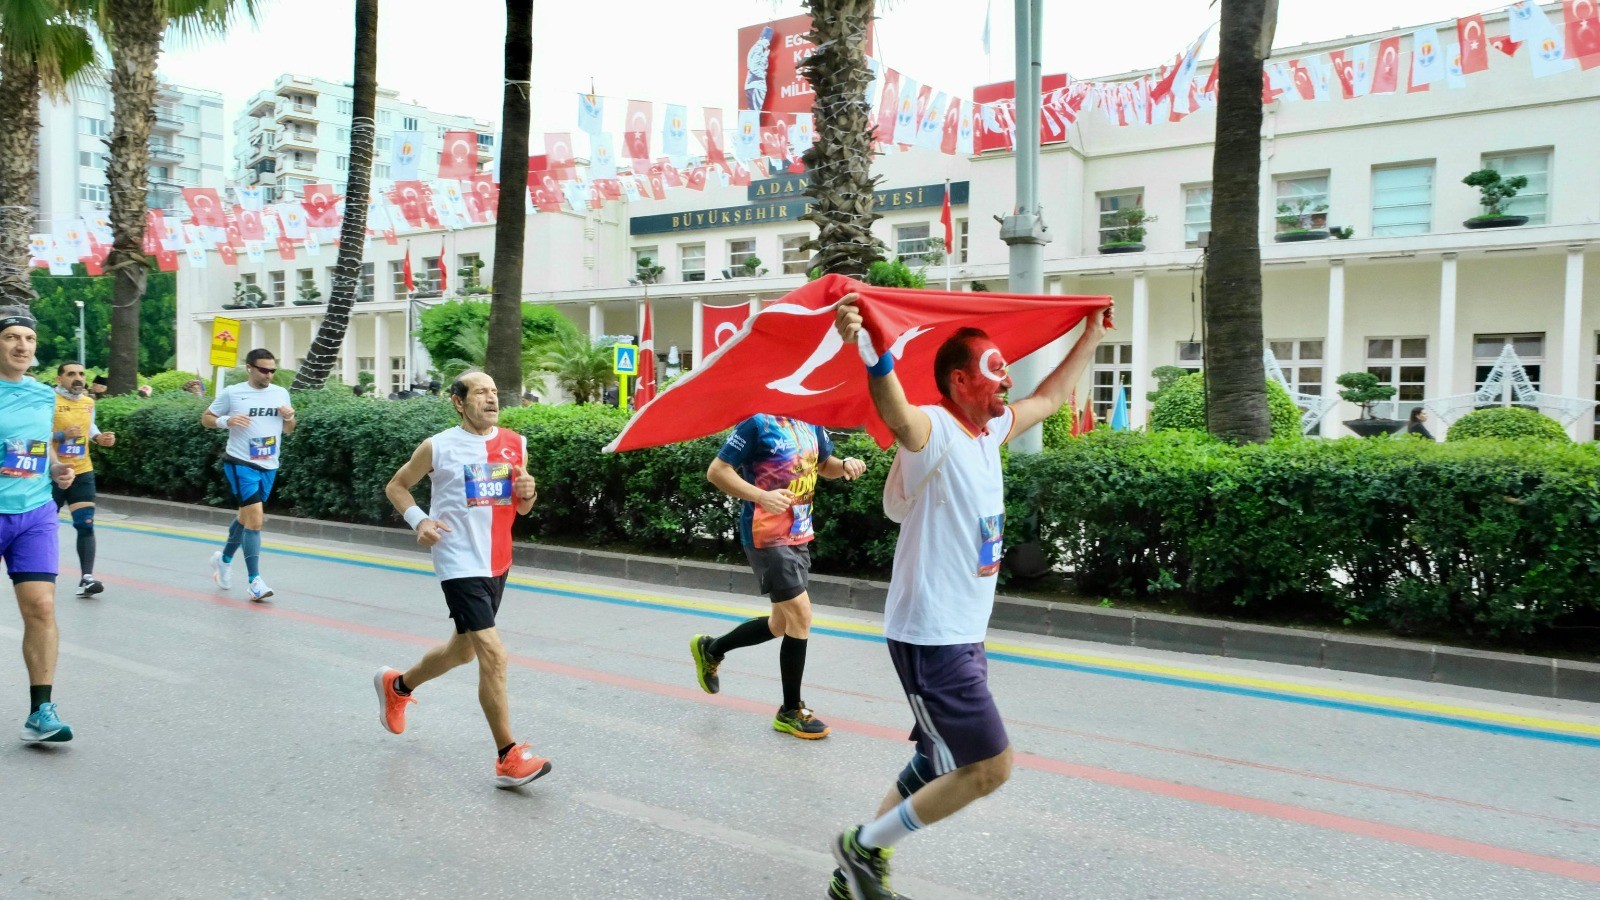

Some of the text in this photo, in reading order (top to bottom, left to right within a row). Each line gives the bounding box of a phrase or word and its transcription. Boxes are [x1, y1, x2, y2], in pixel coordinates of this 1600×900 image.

[756, 178, 809, 197] ADAN
[672, 204, 788, 228] BÜYÜKŞEHİR
[257, 447, 271, 456] 791
[15, 455, 37, 471] 761
[479, 482, 502, 496] 339
